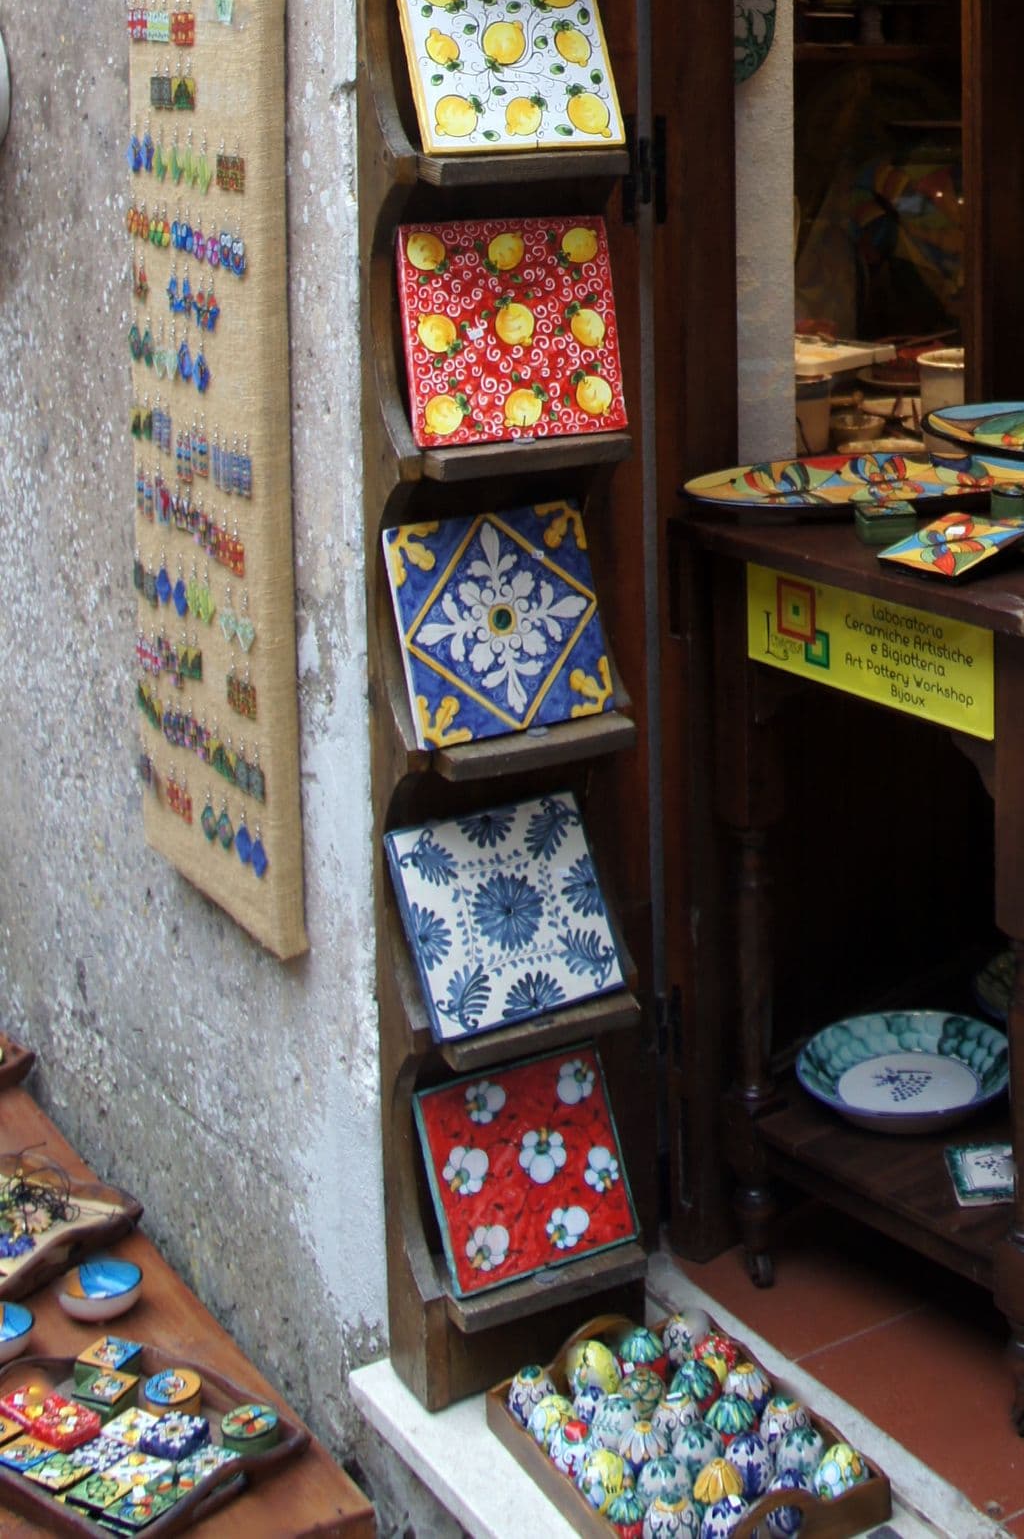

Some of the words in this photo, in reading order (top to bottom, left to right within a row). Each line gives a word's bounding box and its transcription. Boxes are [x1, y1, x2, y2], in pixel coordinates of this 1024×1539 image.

[871, 604, 943, 639] Laboratorio
[845, 613, 910, 646] Ceramiche
[913, 635, 974, 668] Artistiche
[870, 643, 878, 654] e
[881, 642, 946, 677] Bigiotteria
[845, 652, 864, 670] Art
[866, 659, 910, 688] Pottery
[913, 674, 974, 708] Workshop
[890, 684, 926, 708] Bijoux
